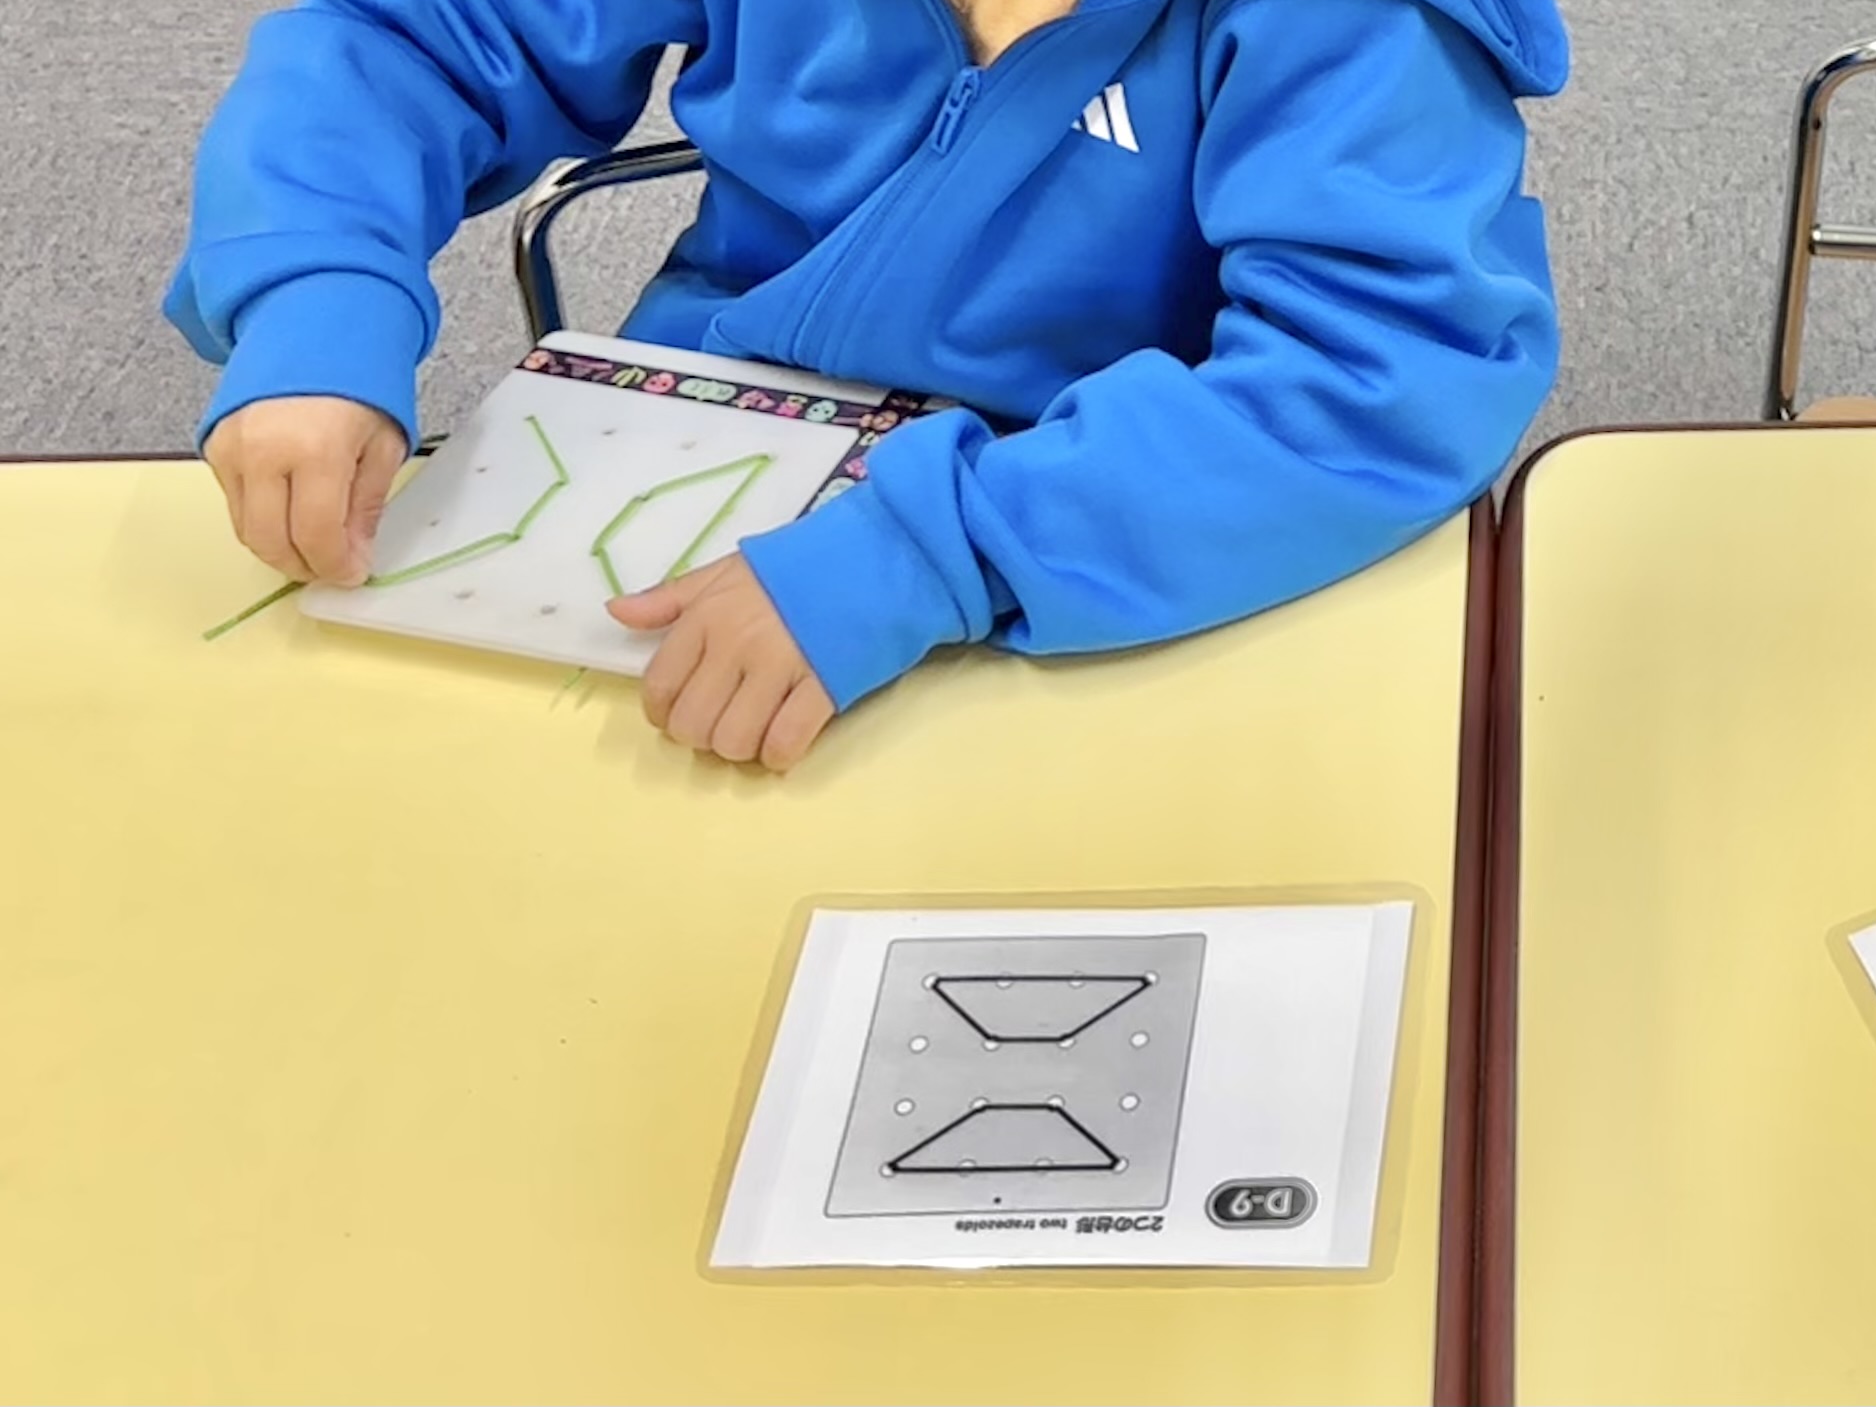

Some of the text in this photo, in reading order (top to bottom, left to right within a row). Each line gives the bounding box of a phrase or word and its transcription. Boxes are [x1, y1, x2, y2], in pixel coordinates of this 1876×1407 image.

[1230, 1186, 1294, 1217] D-9
[955, 1215, 1165, 1233] 2つの台形 two trapezoids
